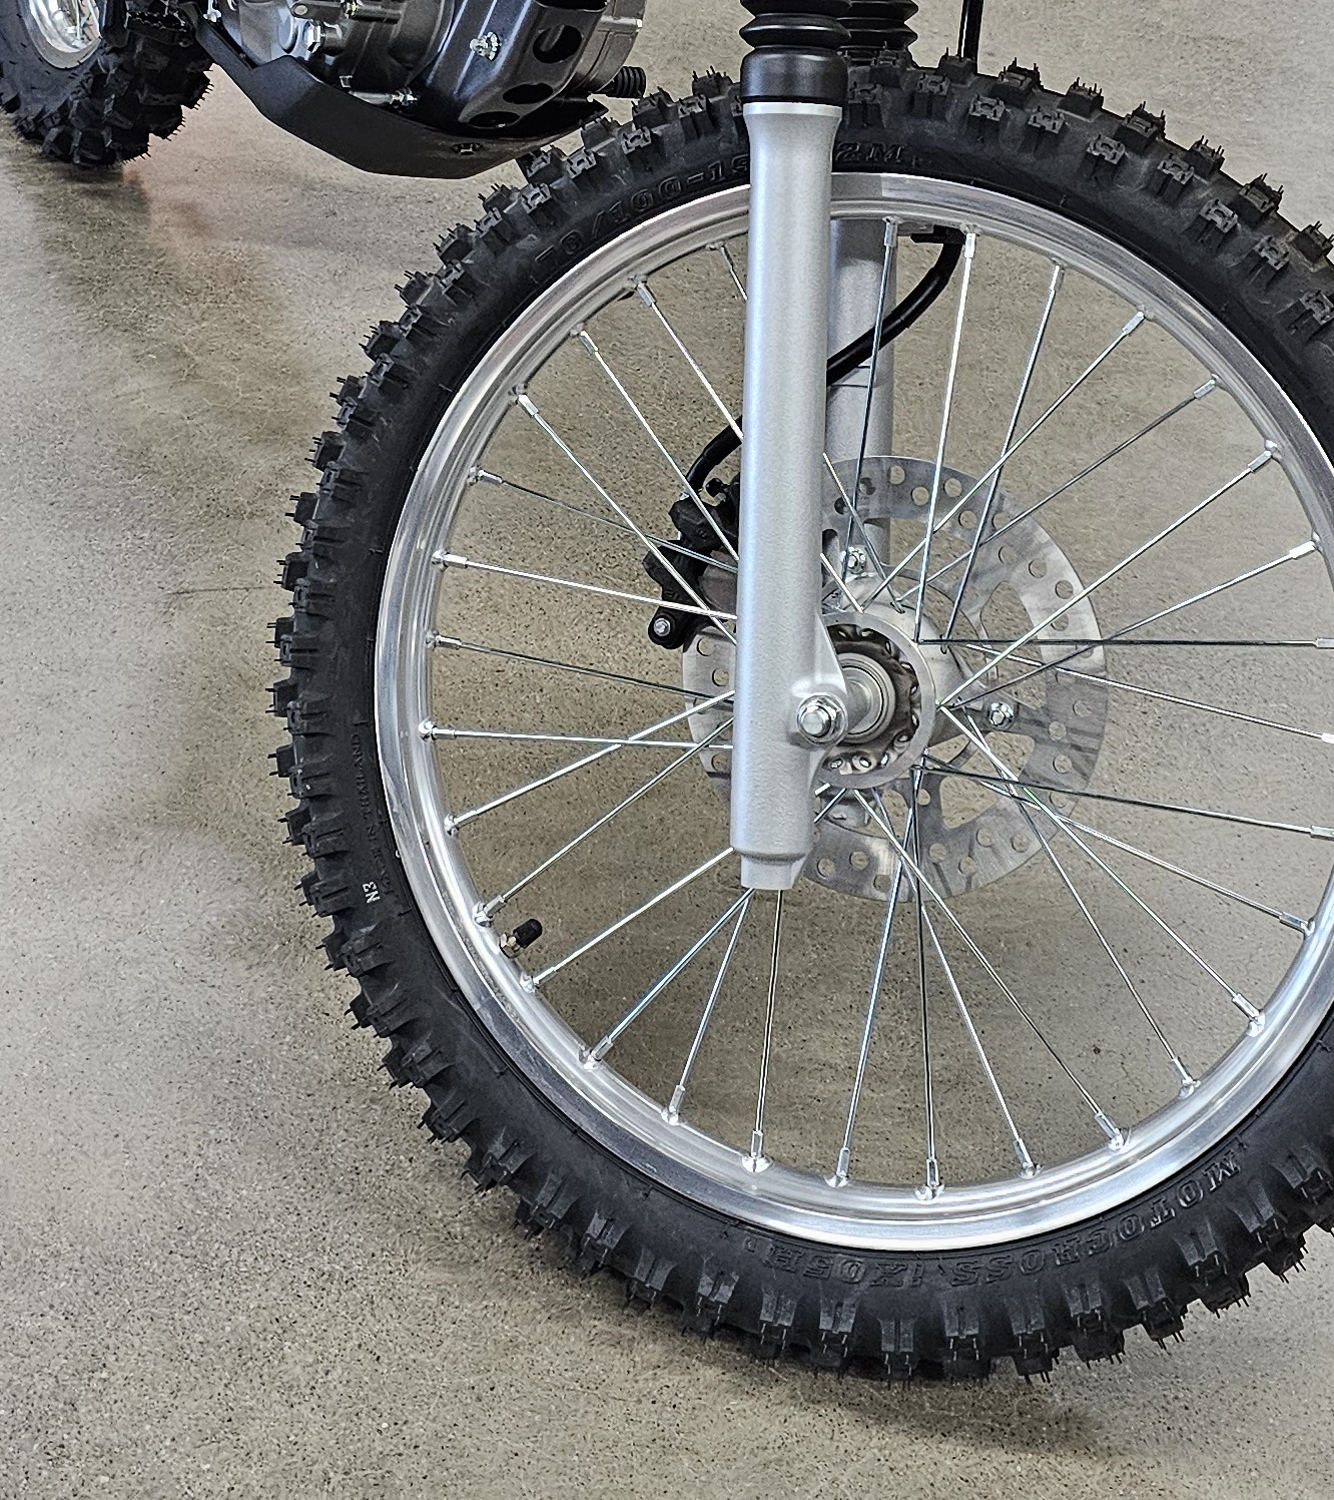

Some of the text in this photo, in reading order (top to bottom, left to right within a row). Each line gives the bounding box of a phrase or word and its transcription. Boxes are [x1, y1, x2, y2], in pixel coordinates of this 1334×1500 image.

[834, 140, 903, 164] 2M
[362, 881, 380, 903] N3
[949, 1149, 1245, 1288] MOTOCROSS
